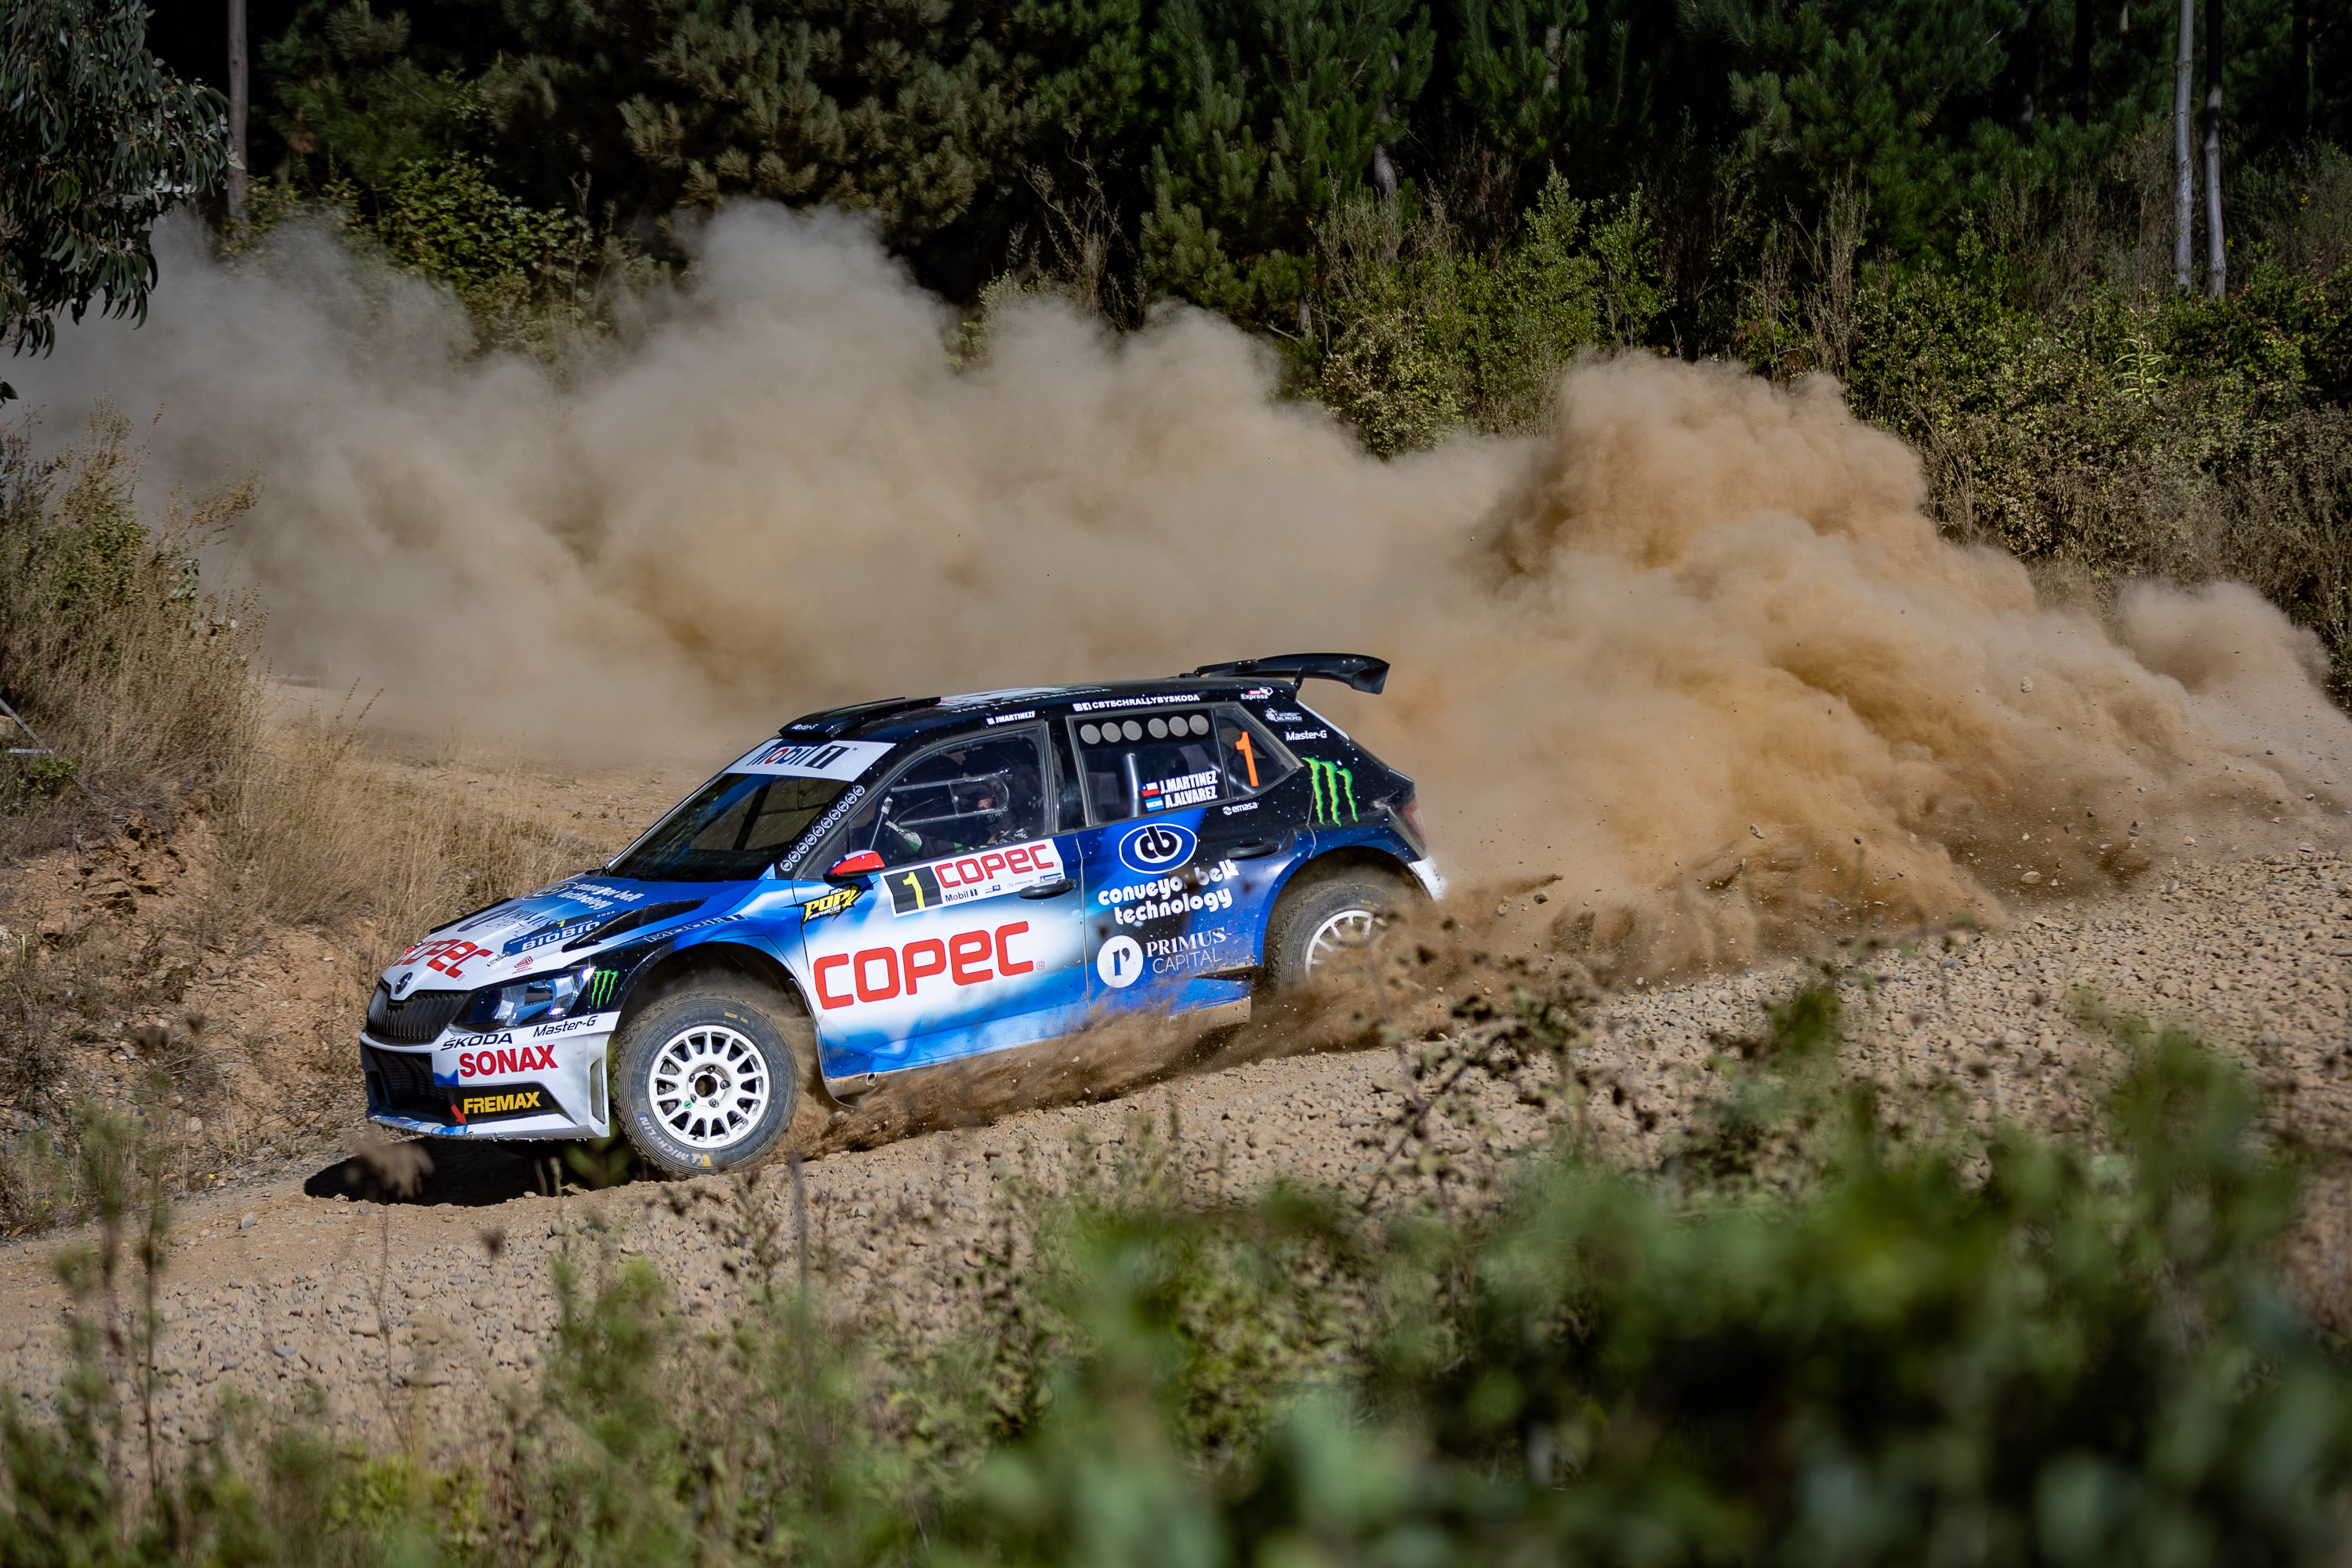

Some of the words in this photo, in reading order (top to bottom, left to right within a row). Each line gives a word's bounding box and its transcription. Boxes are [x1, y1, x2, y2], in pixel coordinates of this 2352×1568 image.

[1092, 694, 1200, 710] CBTECHRALLYBYSKODA
[995, 711, 1036, 724] JMARTINEZF
[1286, 730, 1327, 741] Master-G
[746, 745, 821, 767] Mobil
[1236, 731, 1259, 787] 1
[1160, 770, 1218, 795] J.MARTINEZ
[1164, 785, 1218, 809] A.ALVAREZ
[1232, 803, 1258, 813] emasa
[902, 871, 926, 909] 1
[945, 891, 969, 902] Mobil
[1114, 887, 1233, 925] technology
[1145, 927, 1226, 958] PRIMUS
[1152, 948, 1223, 974] CAPITAL
[533, 1015, 598, 1038] Master-G
[440, 1033, 514, 1051] ŠKODA
[459, 1044, 558, 1078] SONAX
[463, 1091, 541, 1115] FREMAX
